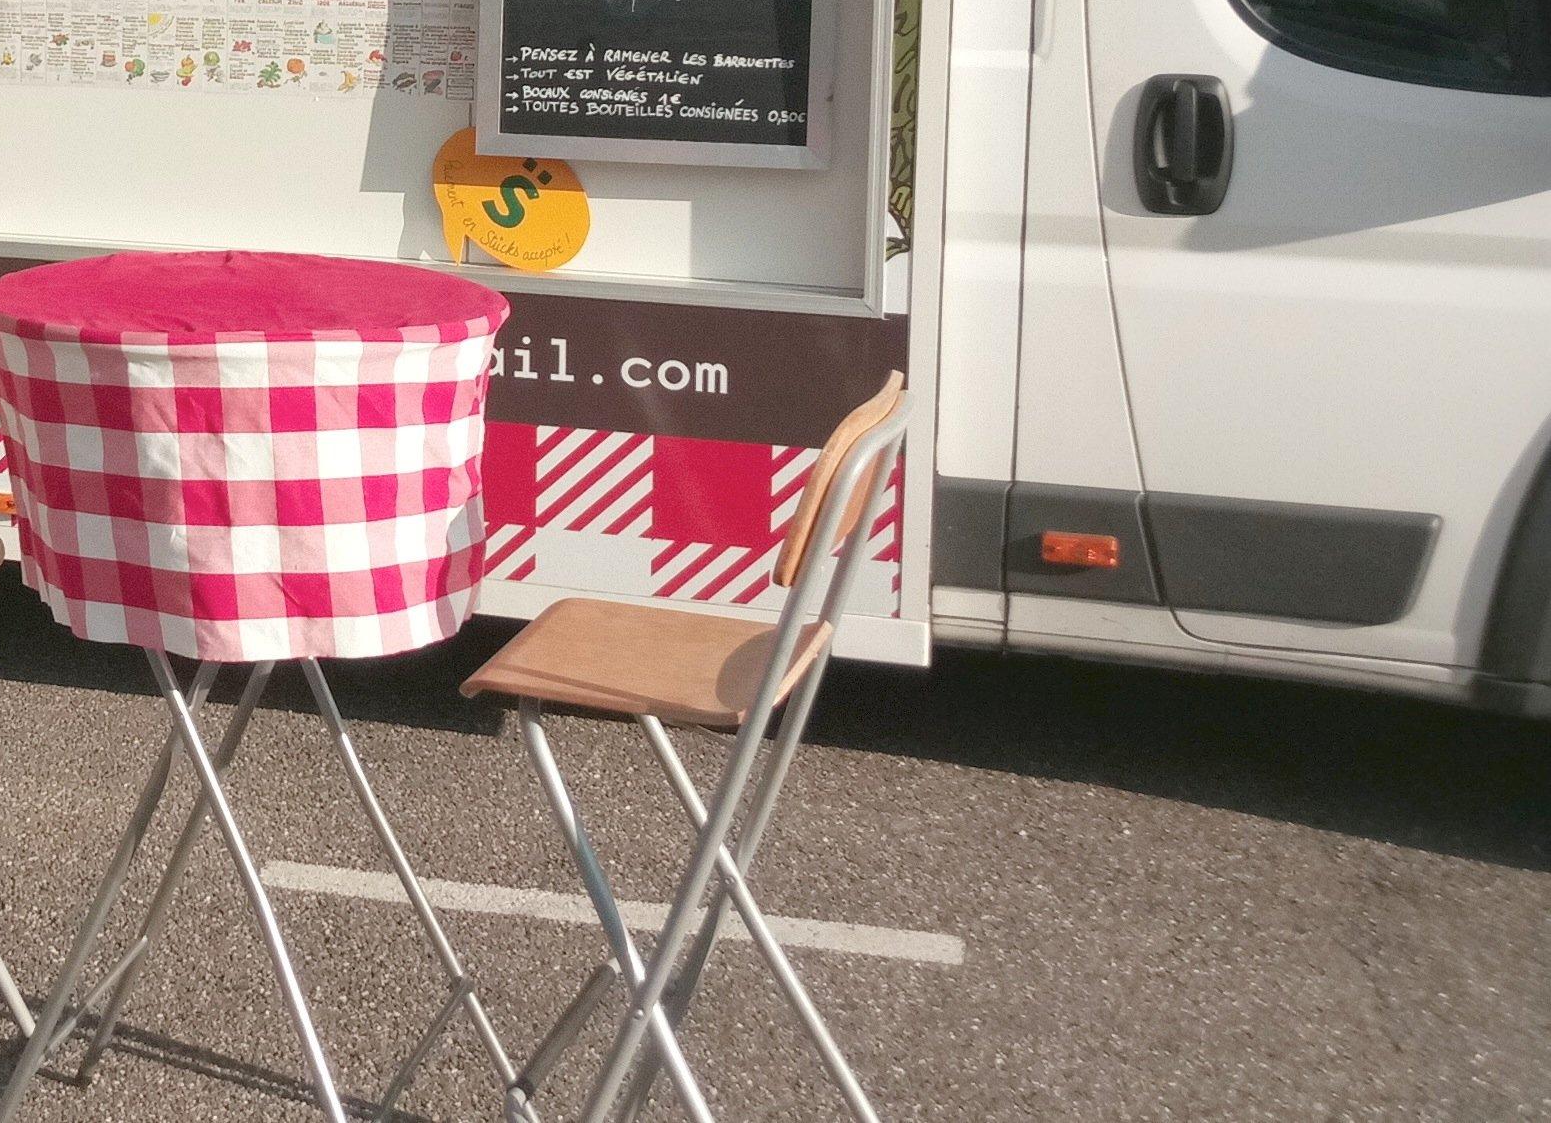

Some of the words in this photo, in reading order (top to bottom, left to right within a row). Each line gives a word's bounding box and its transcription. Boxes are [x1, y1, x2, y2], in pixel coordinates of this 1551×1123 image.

[520, 47, 578, 62] PENSEZ
[585, 43, 595, 63] À
[603, 50, 672, 64] RAMENER
[682, 51, 707, 66] LES
[713, 54, 796, 69] BARQUETTES
[520, 68, 557, 80] TOUT
[564, 69, 594, 80] EST
[522, 85, 570, 100] BOCAUX
[522, 100, 579, 114] TOUTES
[585, 101, 673, 119] BOUTEILLES
[679, 99, 759, 122] CONSIGNÉES
